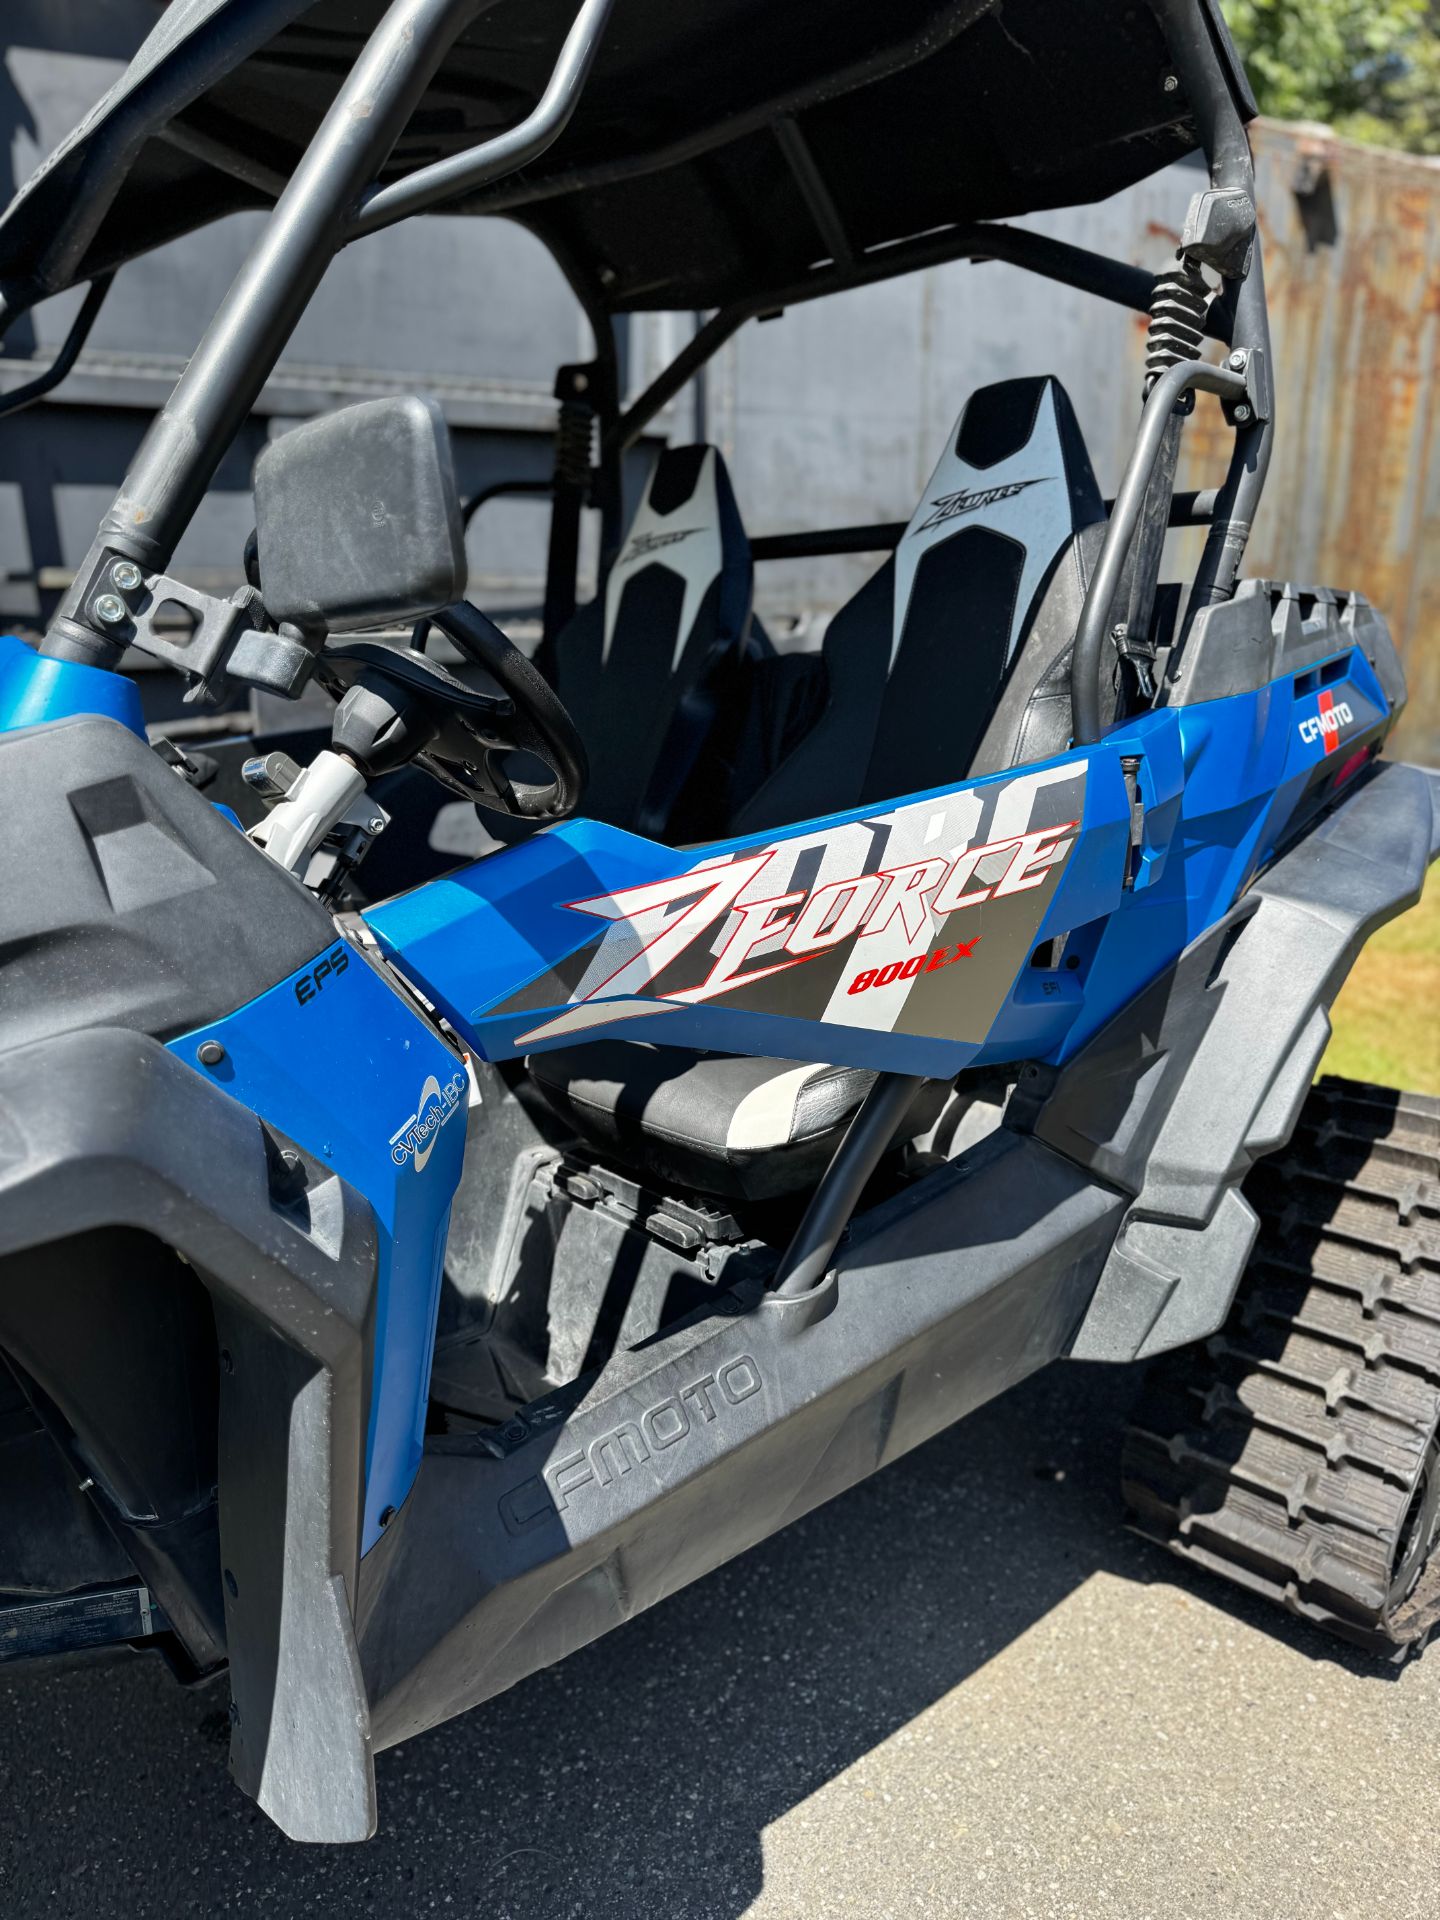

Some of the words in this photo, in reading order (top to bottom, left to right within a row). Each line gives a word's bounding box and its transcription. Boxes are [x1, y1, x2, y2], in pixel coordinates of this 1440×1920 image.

[1298, 702, 1354, 744] CFMOTO
[294, 945, 349, 1007] EPS
[497, 1353, 763, 1538] CFMOTO
